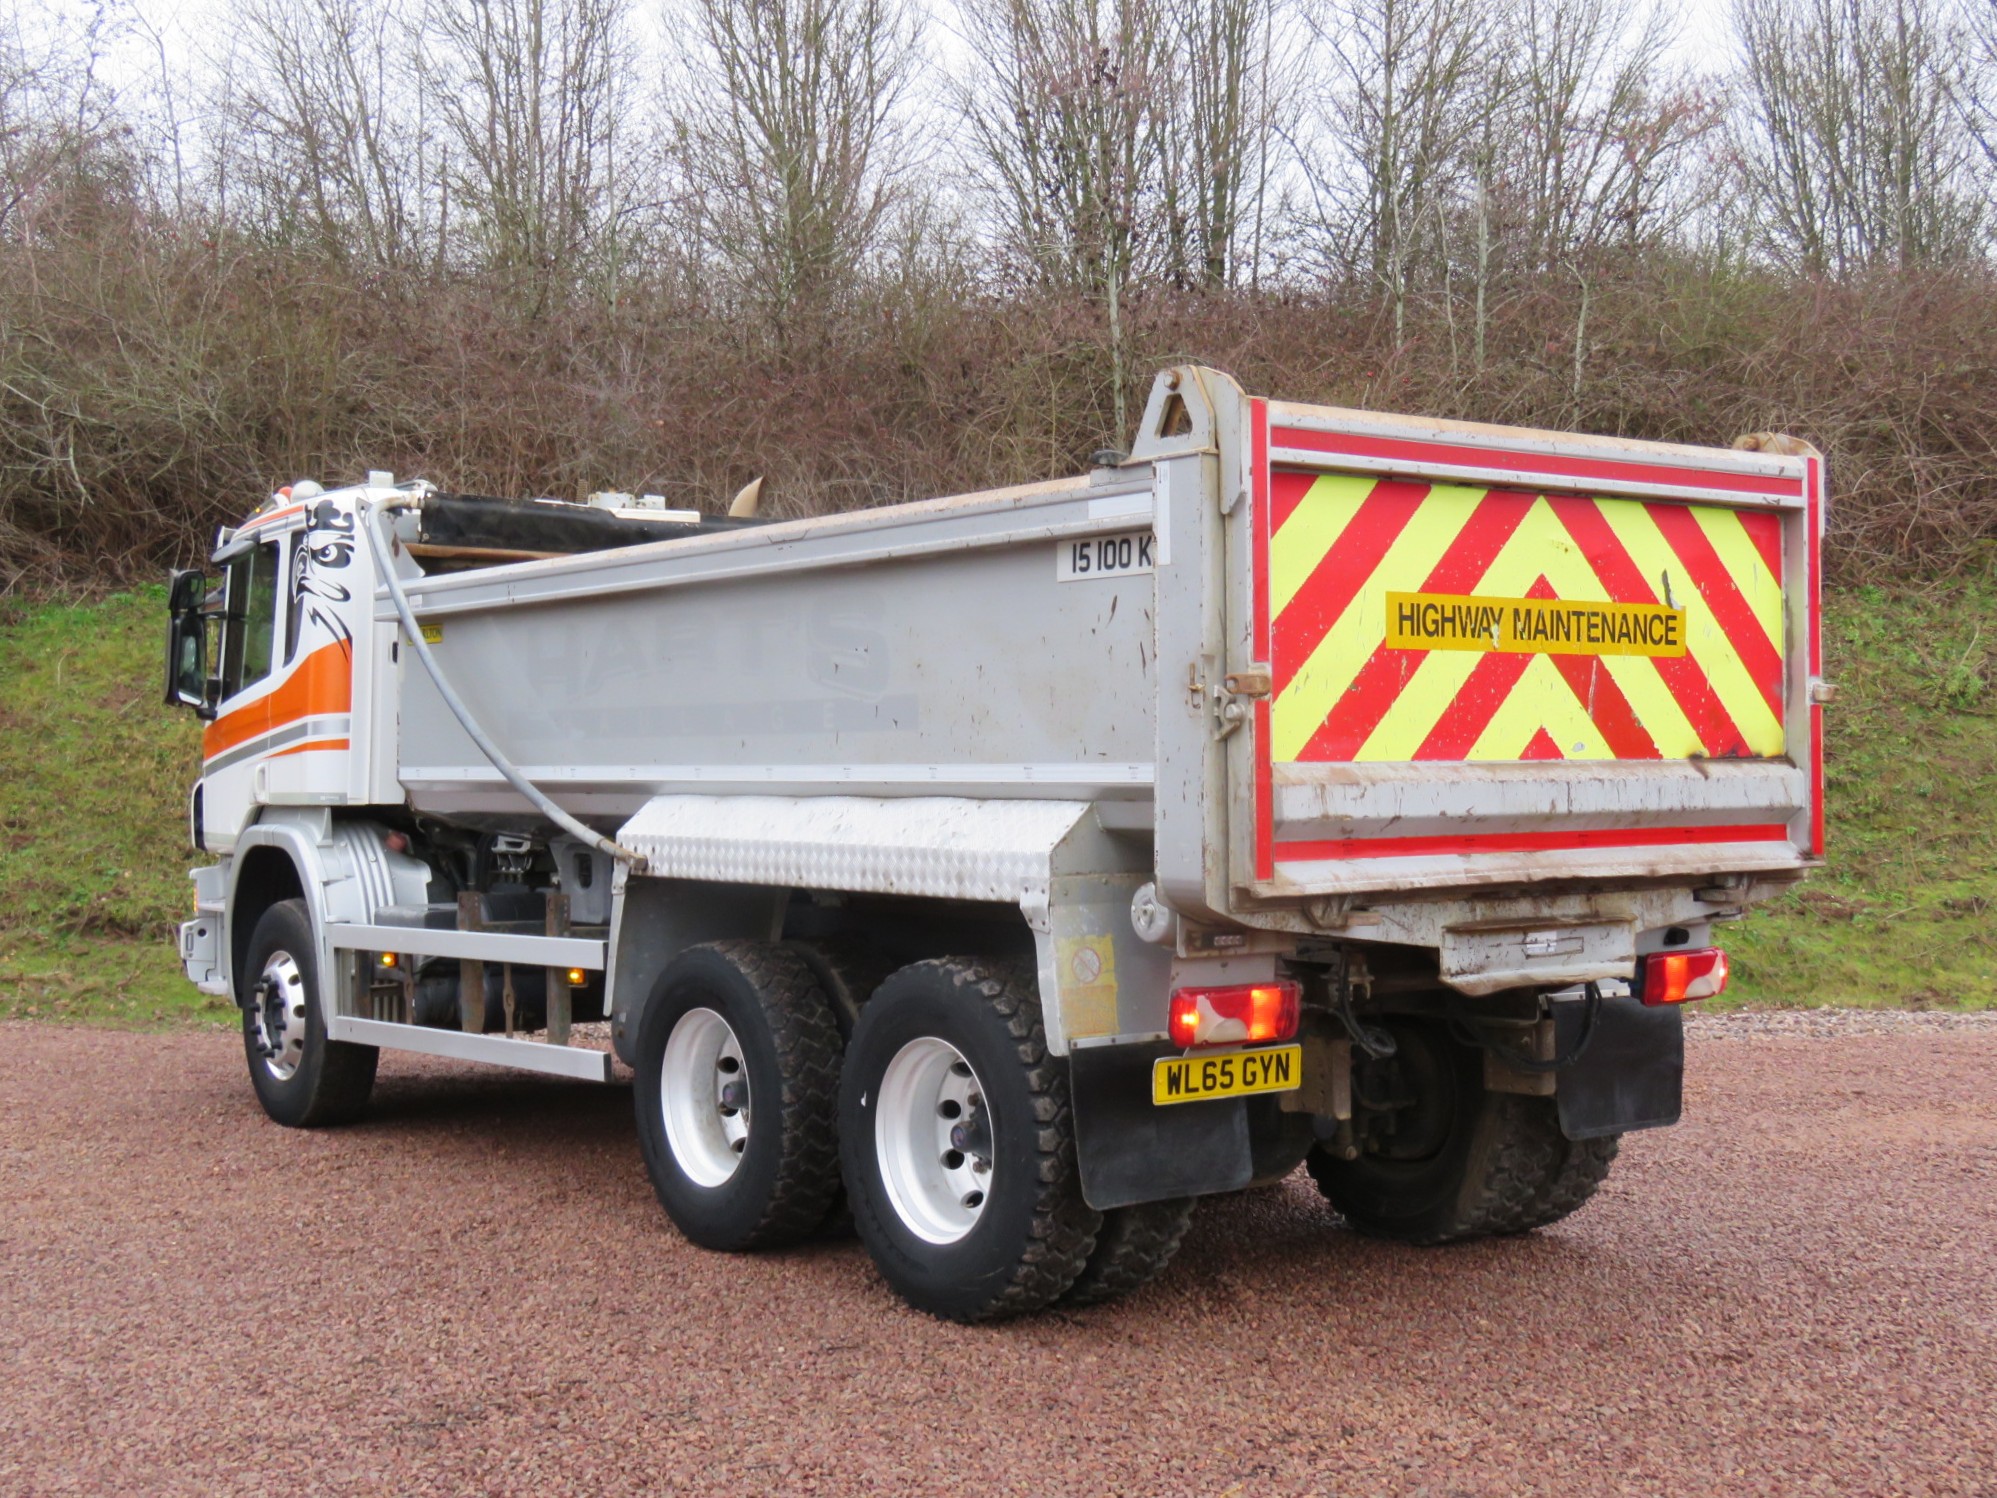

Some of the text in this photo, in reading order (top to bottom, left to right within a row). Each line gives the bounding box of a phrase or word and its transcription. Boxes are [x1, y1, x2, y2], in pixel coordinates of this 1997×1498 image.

[1072, 535, 1152, 573] 15 100 K
[1398, 602, 1678, 646] HIGHWAY MAINTENANCE
[1167, 1052, 1290, 1095] WL65 GYN
